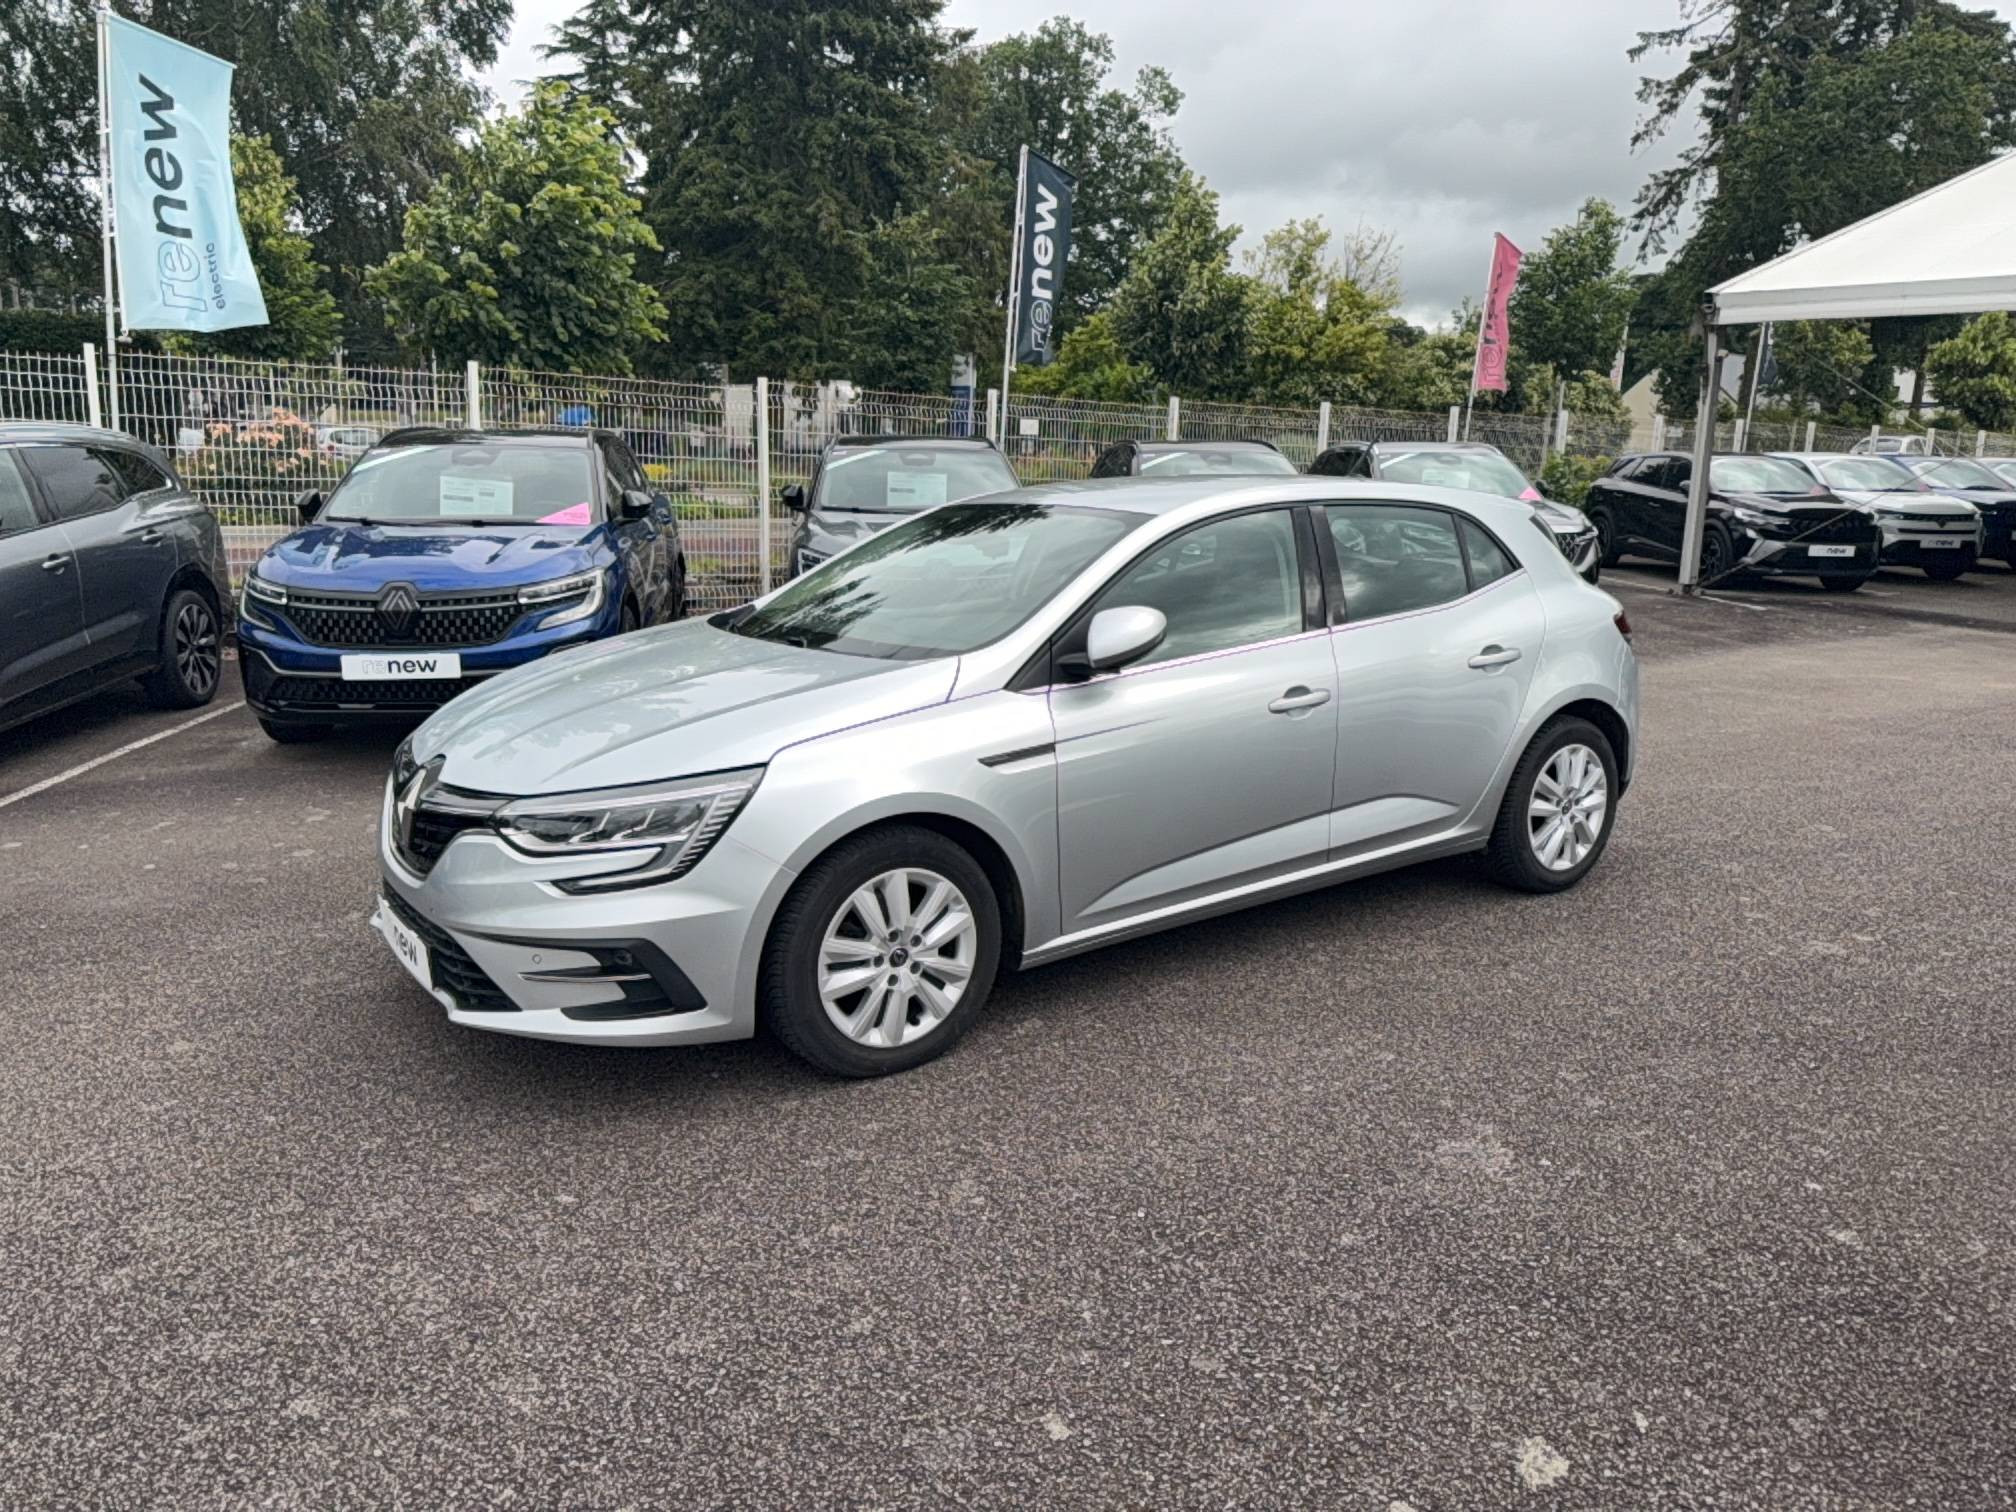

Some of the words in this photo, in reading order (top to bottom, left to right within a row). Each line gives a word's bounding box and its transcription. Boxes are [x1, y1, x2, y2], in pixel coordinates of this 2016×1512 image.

[138, 72, 208, 312] renew
[205, 242, 227, 310] electric
[1030, 183, 1058, 351] renew
